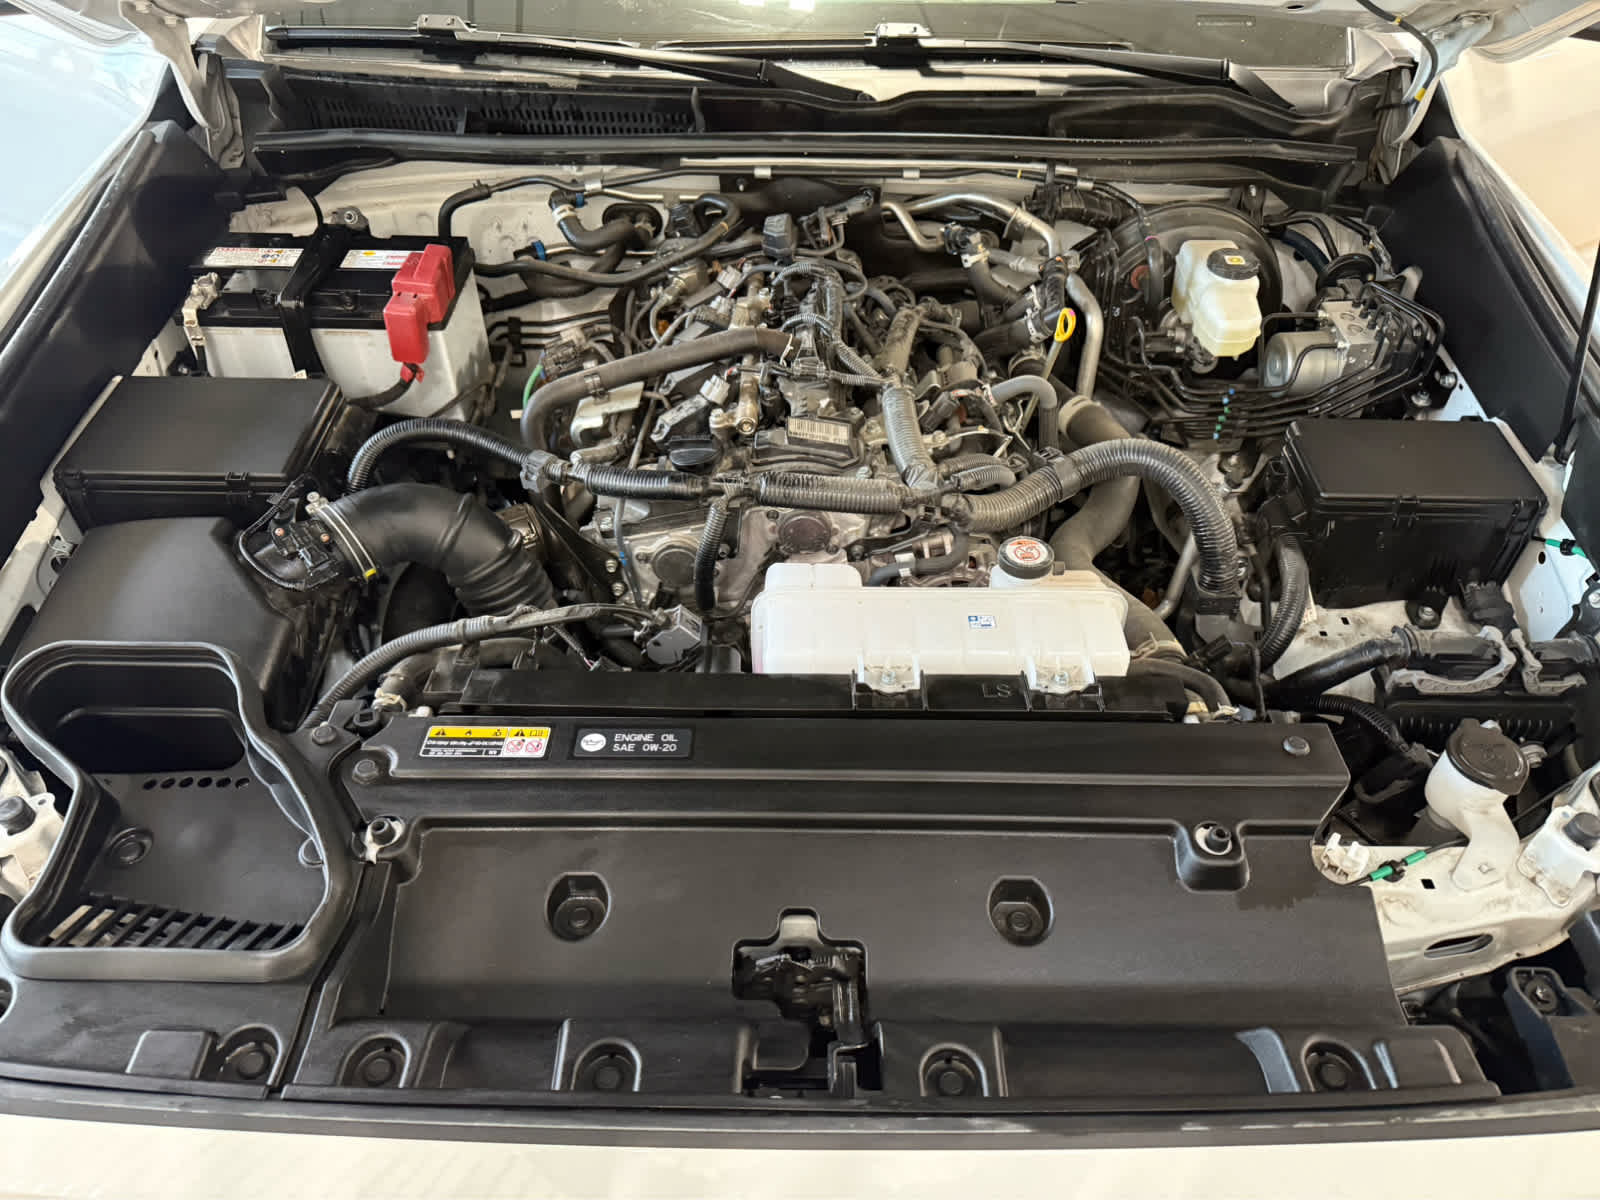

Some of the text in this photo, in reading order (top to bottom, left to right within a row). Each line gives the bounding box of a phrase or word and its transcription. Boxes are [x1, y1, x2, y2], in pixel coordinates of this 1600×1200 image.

[982, 682, 1011, 698] LS
[614, 733, 678, 742] ENGINE OIL
[612, 743, 677, 752] SAE 0W-20
